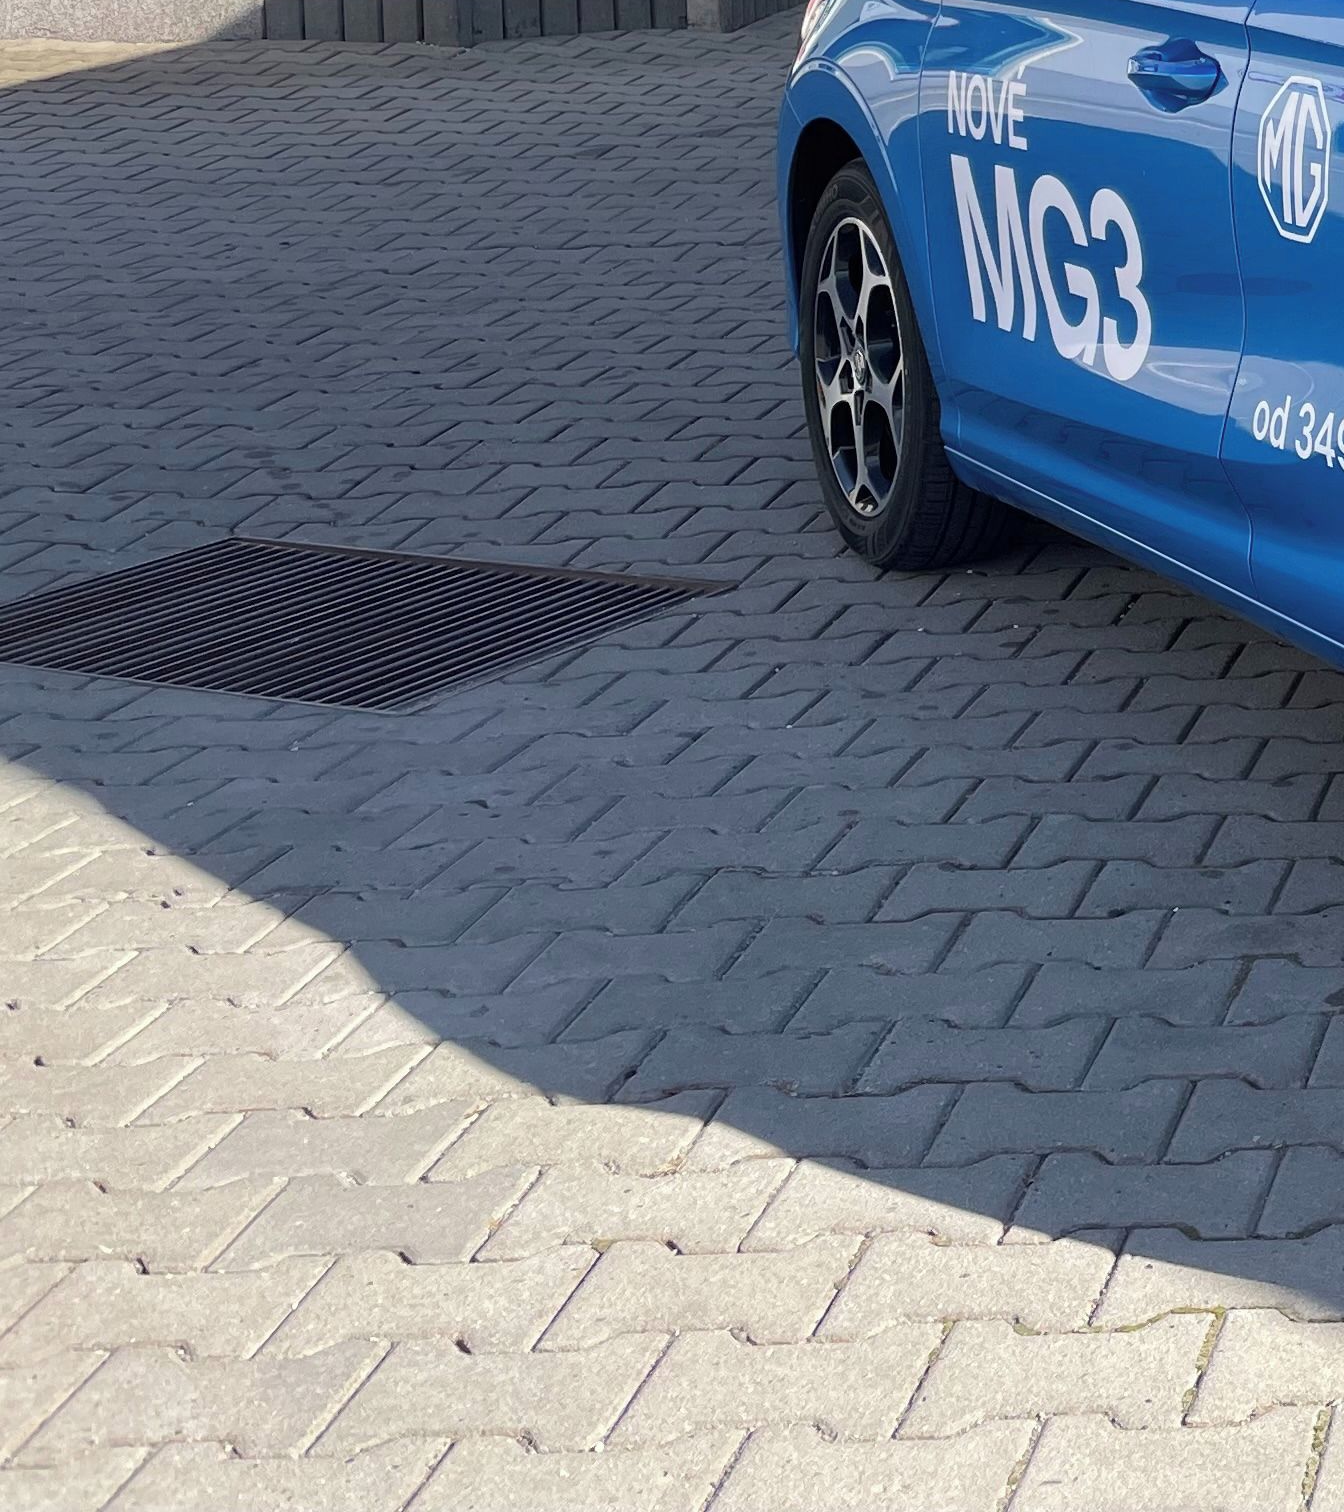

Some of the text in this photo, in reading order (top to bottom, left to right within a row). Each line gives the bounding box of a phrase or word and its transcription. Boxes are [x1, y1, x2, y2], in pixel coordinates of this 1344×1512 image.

[947, 65, 1028, 151] NOVÉ
[1262, 90, 1325, 229] MG
[951, 154, 1152, 381] MG3
[1252, 395, 1288, 450] od
